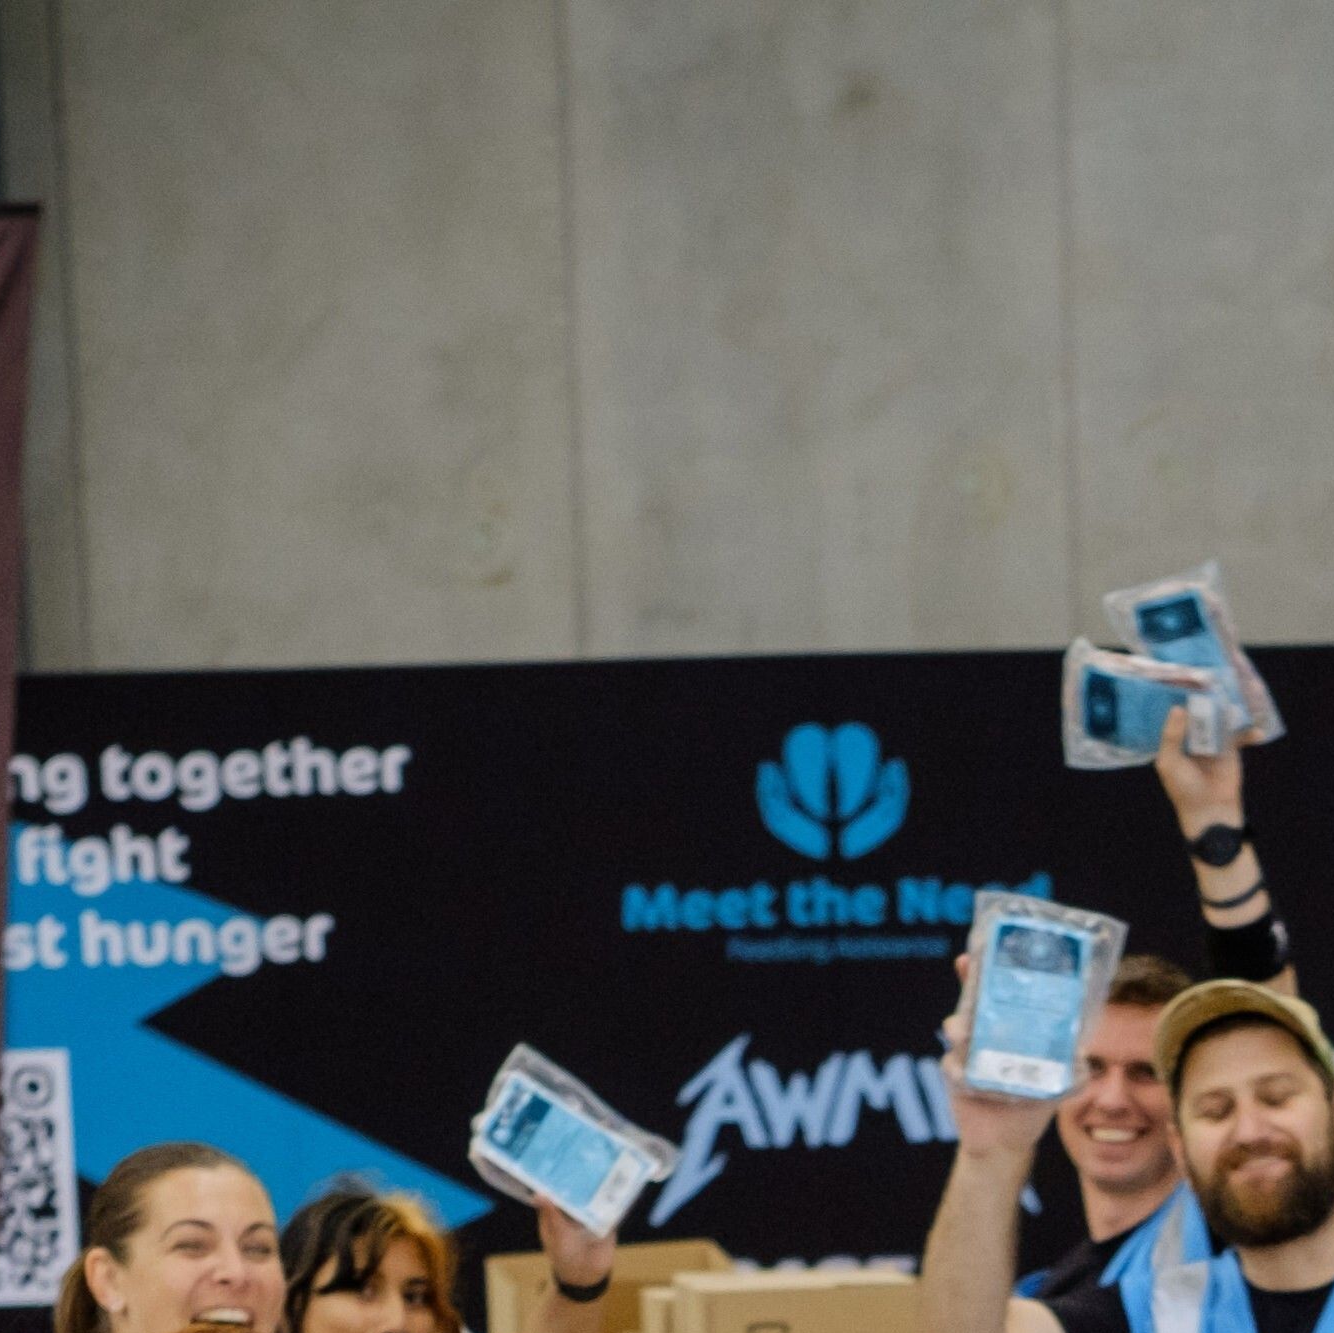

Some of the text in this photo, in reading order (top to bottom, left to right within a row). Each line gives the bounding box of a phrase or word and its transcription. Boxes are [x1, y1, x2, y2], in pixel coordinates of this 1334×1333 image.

[8, 735, 413, 815] ng together
[17, 822, 192, 897] fight
[621, 872, 1054, 931] Meet the Ned
[2, 908, 335, 977] st hunger
